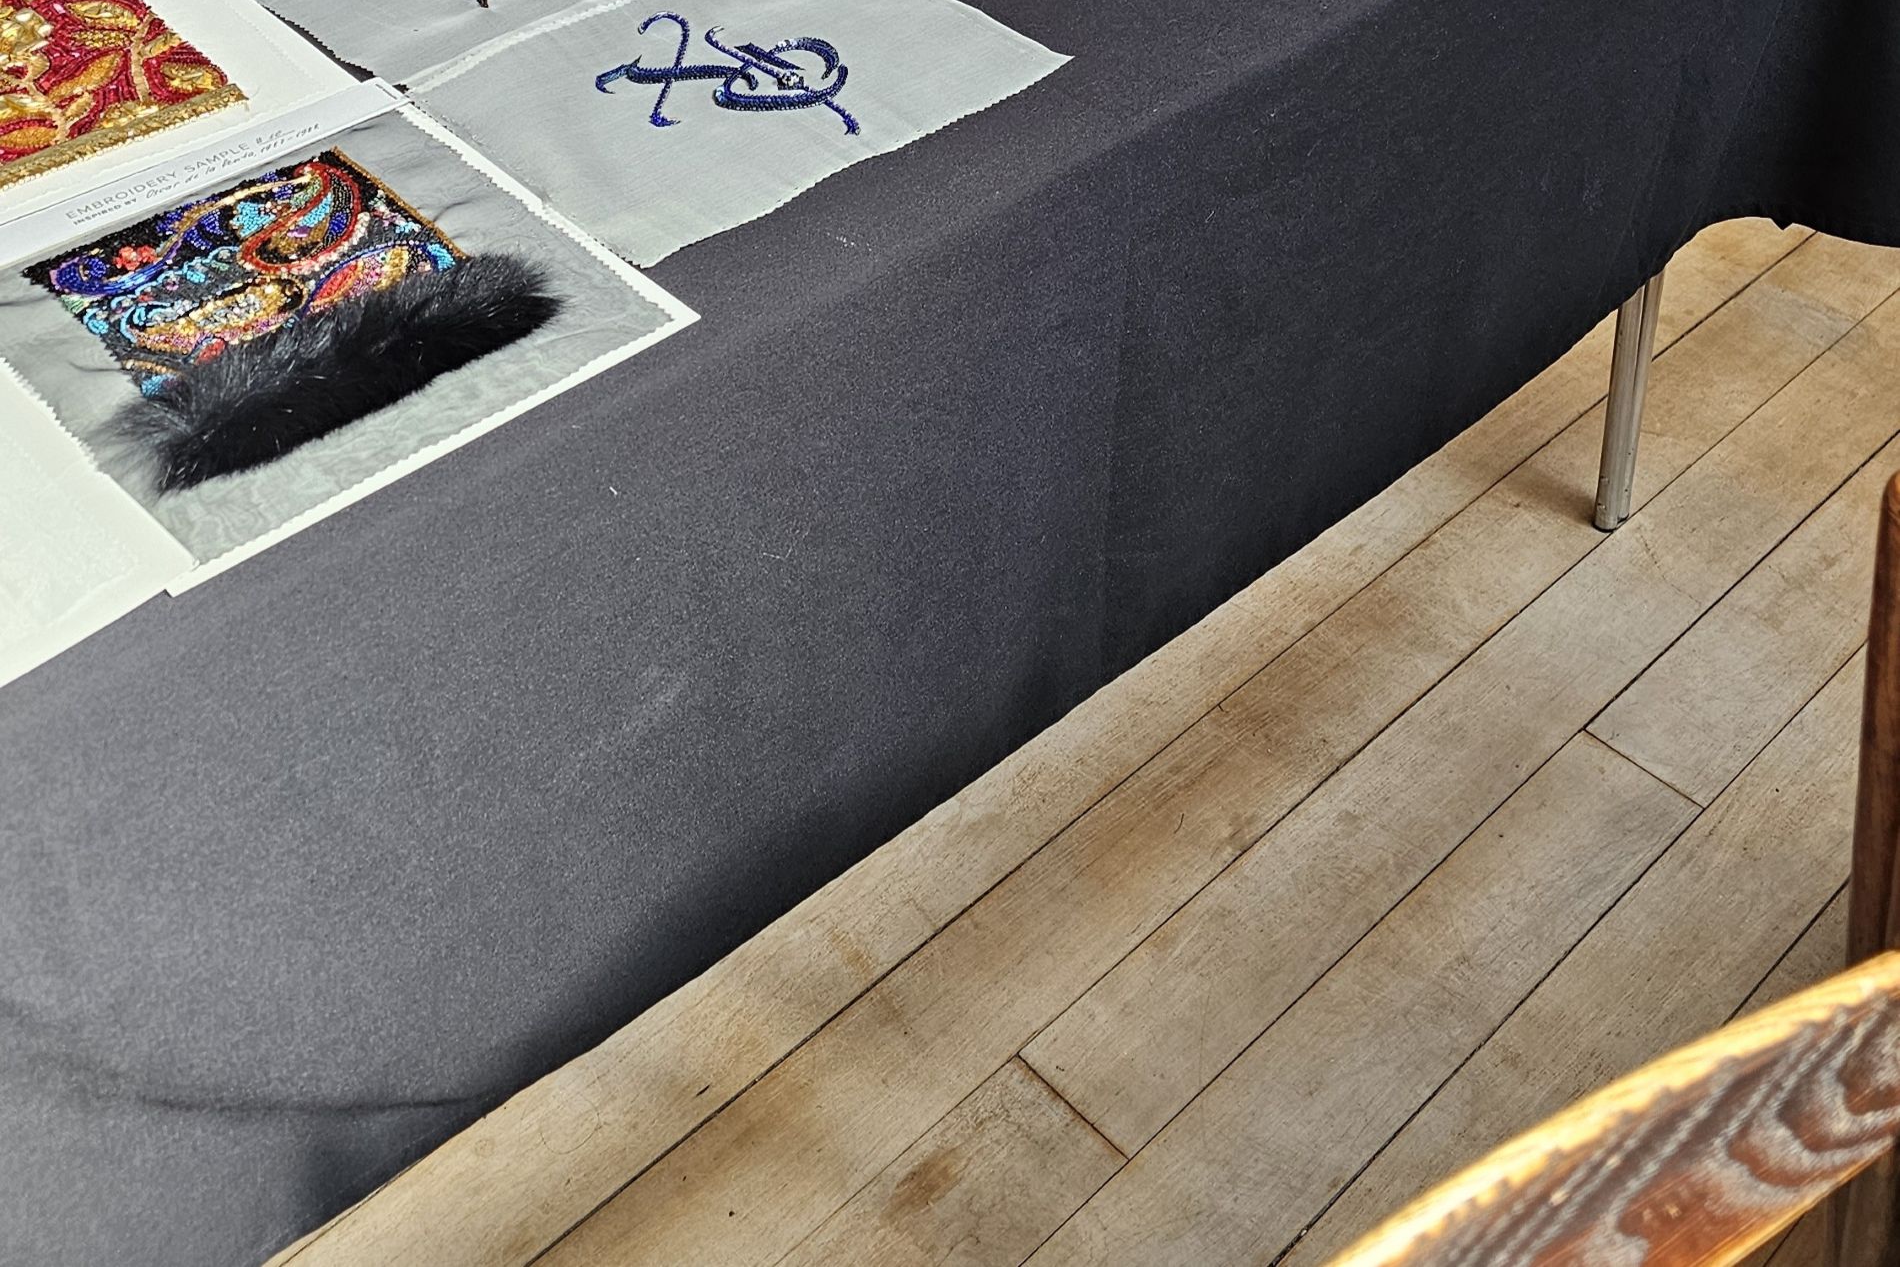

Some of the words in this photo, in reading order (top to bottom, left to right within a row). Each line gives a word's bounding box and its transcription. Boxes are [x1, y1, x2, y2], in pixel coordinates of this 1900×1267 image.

[64, 170, 177, 220] EMBROIDERY
[184, 141, 251, 174] SAMPLE
[73, 204, 122, 226] INSPIRED
[124, 197, 138, 207] BY
